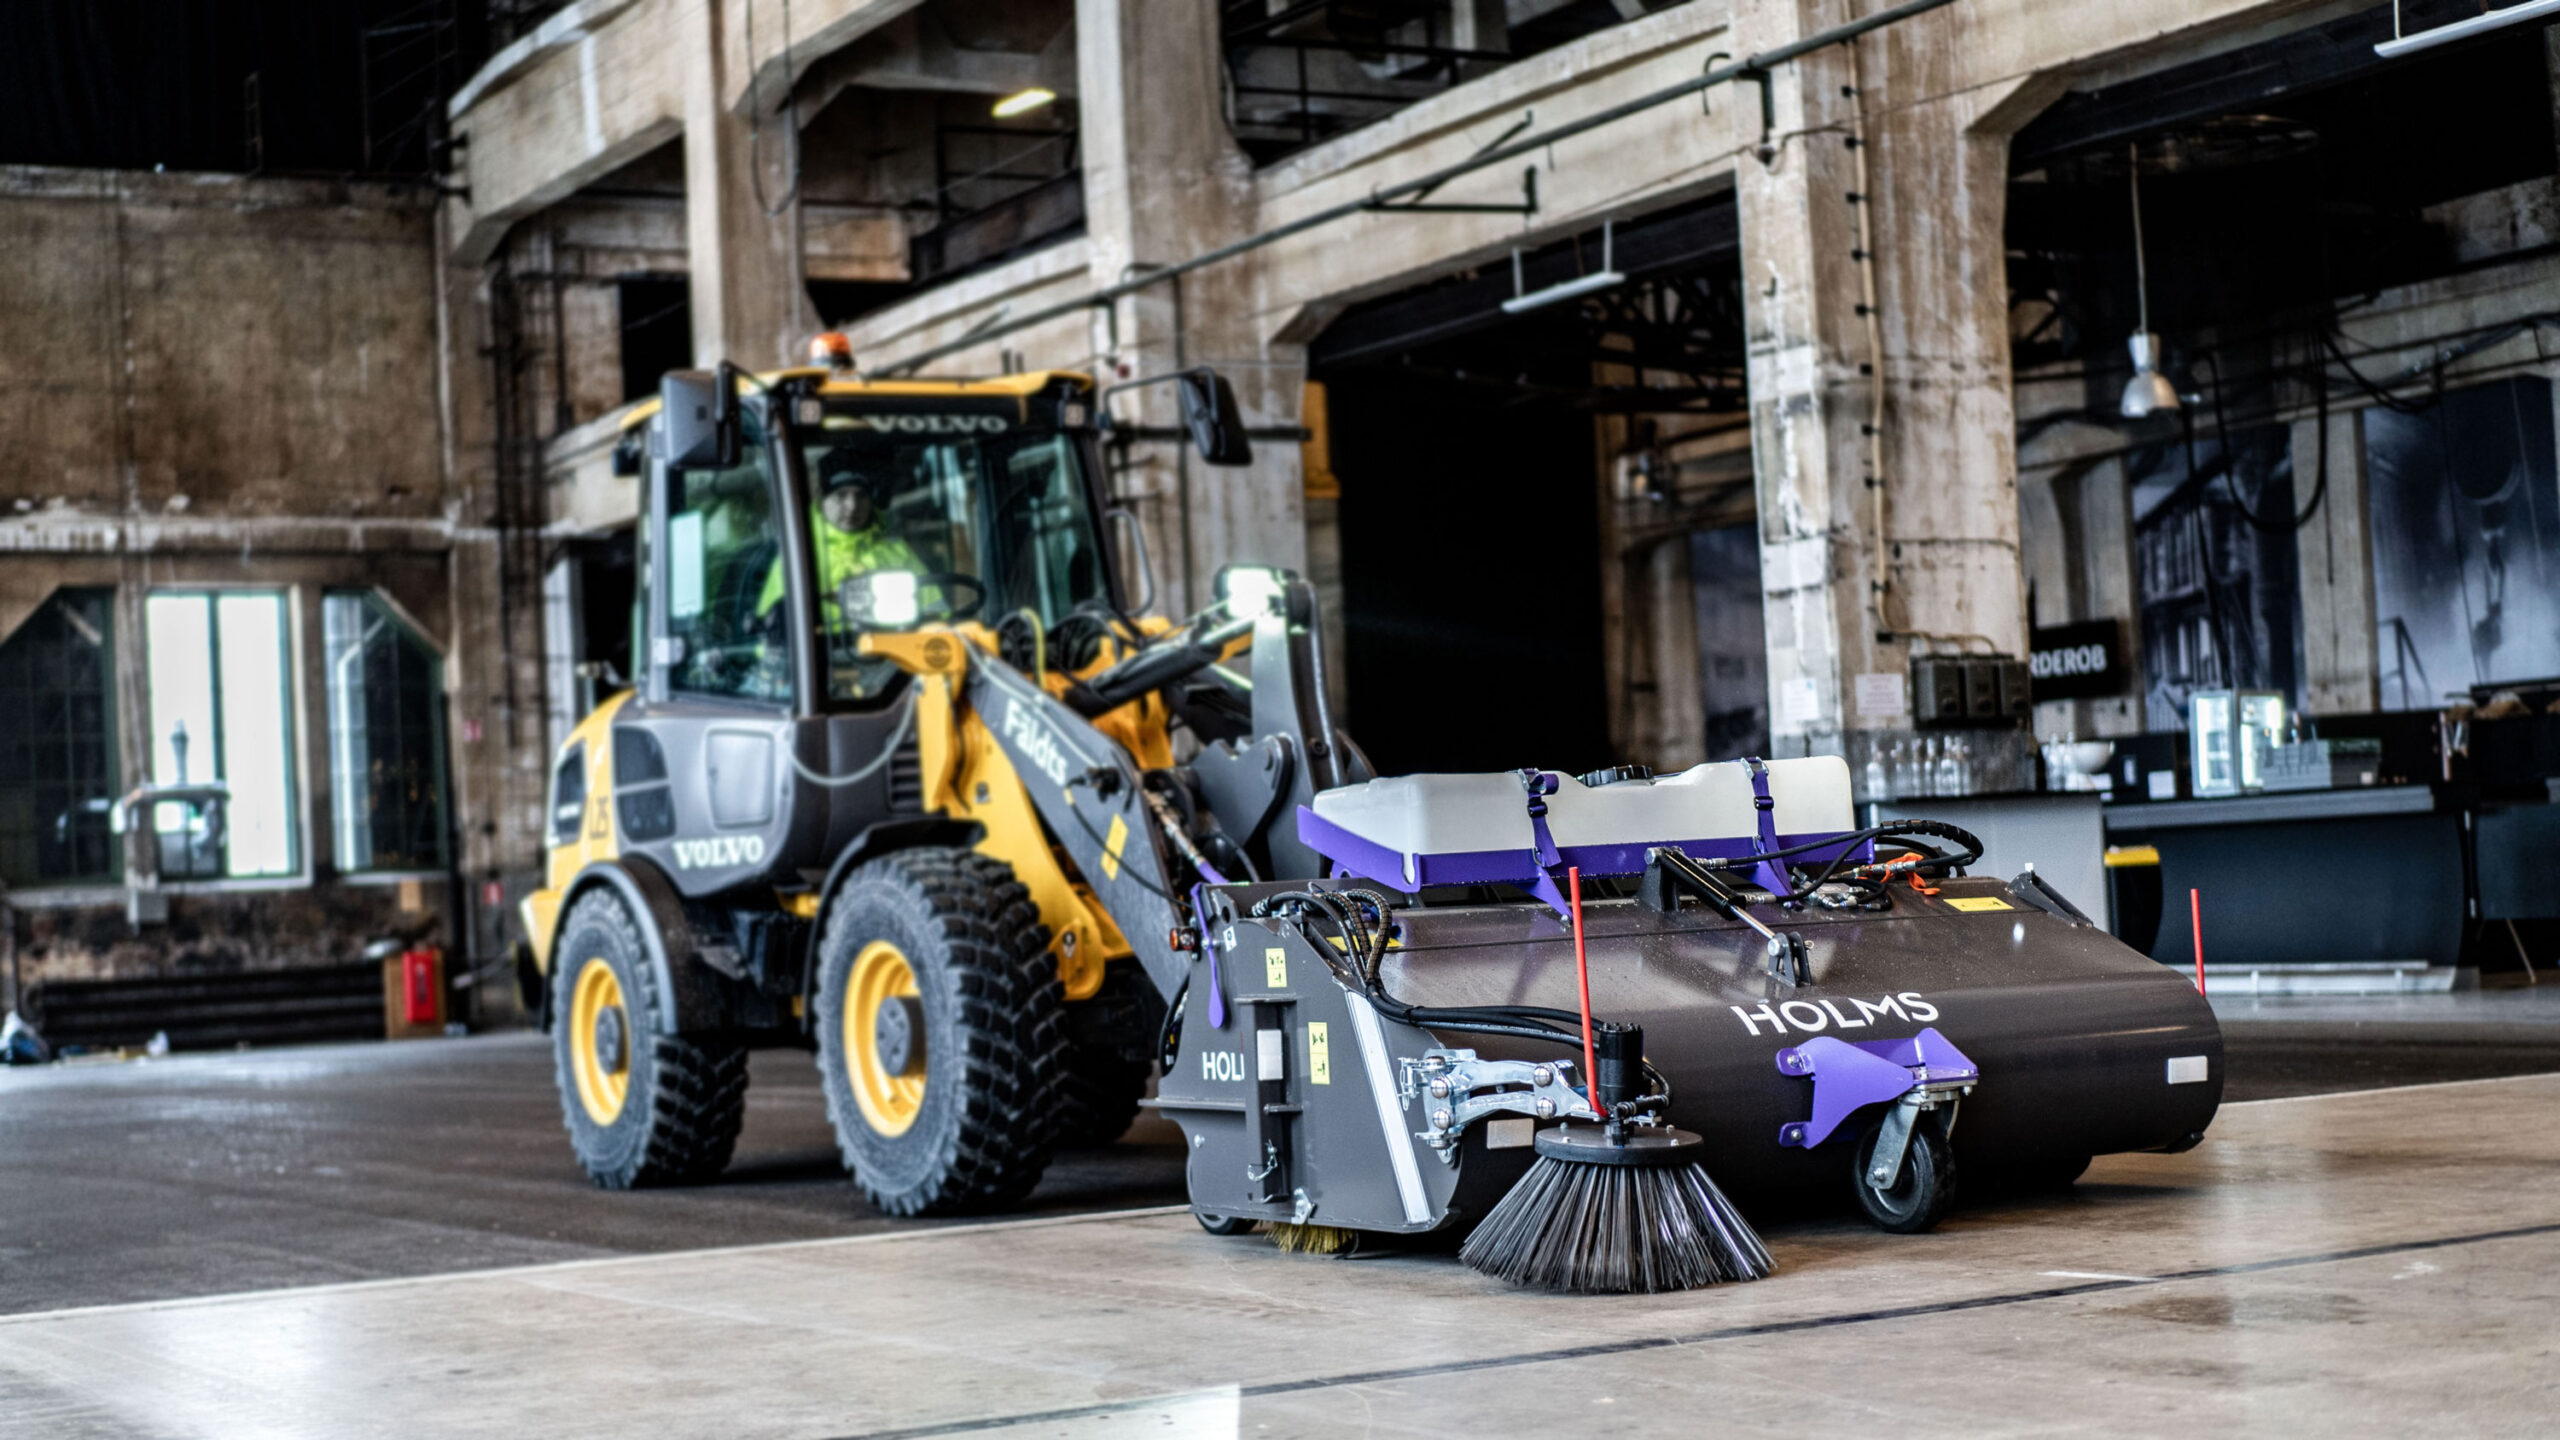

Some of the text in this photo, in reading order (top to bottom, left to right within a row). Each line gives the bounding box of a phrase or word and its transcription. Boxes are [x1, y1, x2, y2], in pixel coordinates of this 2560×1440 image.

[864, 414, 1008, 434] VOLVO
[673, 835, 765, 870] VOLVO
[1730, 992, 1939, 1036] HOLMS
[1202, 1051, 1245, 1081] HOL
